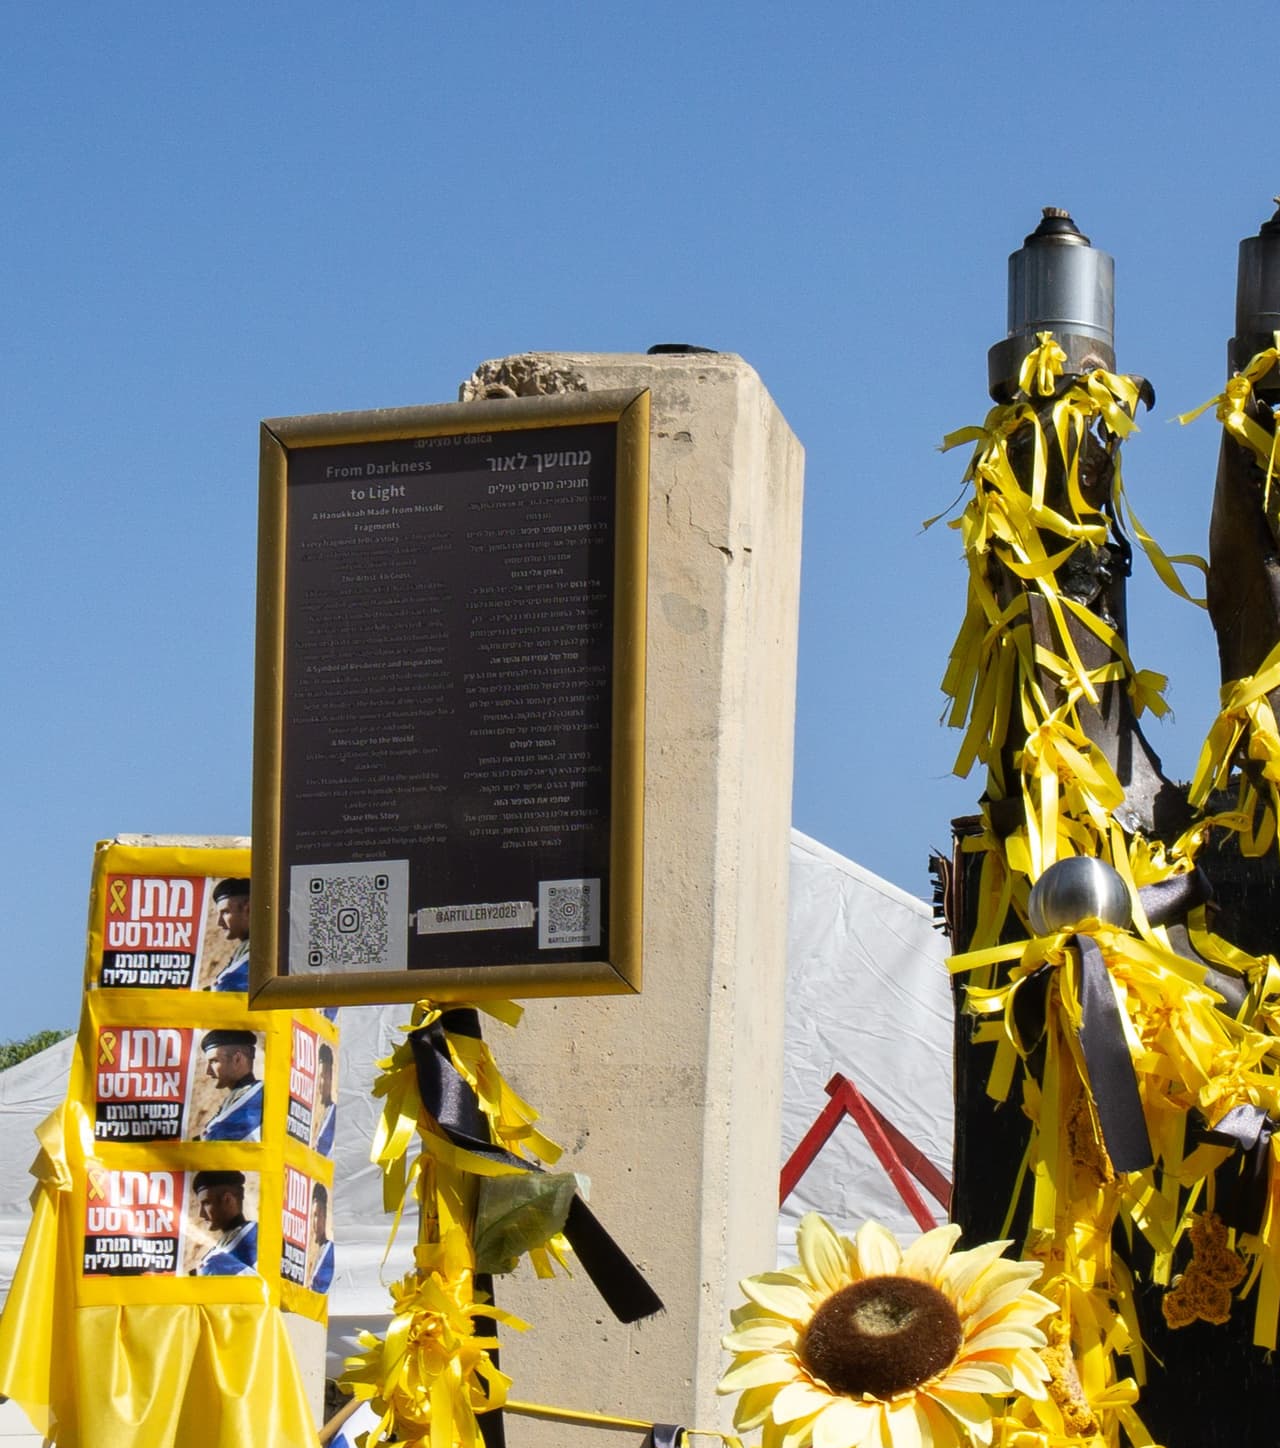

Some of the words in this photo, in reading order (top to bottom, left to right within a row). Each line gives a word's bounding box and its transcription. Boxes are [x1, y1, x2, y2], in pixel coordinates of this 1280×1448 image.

[326, 465, 362, 478] From
[366, 460, 432, 475] Darkness
[486, 452, 528, 472] לאור
[532, 450, 592, 473] מחושך
[488, 482, 516, 495] טילים
[556, 478, 589, 489] חנוכיה
[350, 489, 365, 500] to
[369, 484, 406, 501] Light
[131, 879, 194, 921] מתן
[436, 906, 517, 923] @ARTILLERY2026
[109, 922, 192, 947] אנגרסט
[115, 953, 148, 968] תורנו
[150, 954, 190, 968] עכשיו
[140, 969, 190, 984] להילחם
[120, 1029, 182, 1072] מתן
[98, 1072, 180, 1098] אנגרסט
[106, 1105, 138, 1120] תורנו
[140, 1104, 179, 1119] עכשיו
[132, 1120, 178, 1136] להילחם
[110, 1170, 174, 1208] מתן
[88, 1207, 174, 1234] אנגרסט
[96, 1238, 130, 1252] תורנו
[132, 1238, 174, 1254] עכשיו
[122, 1253, 174, 1269] להילחם
